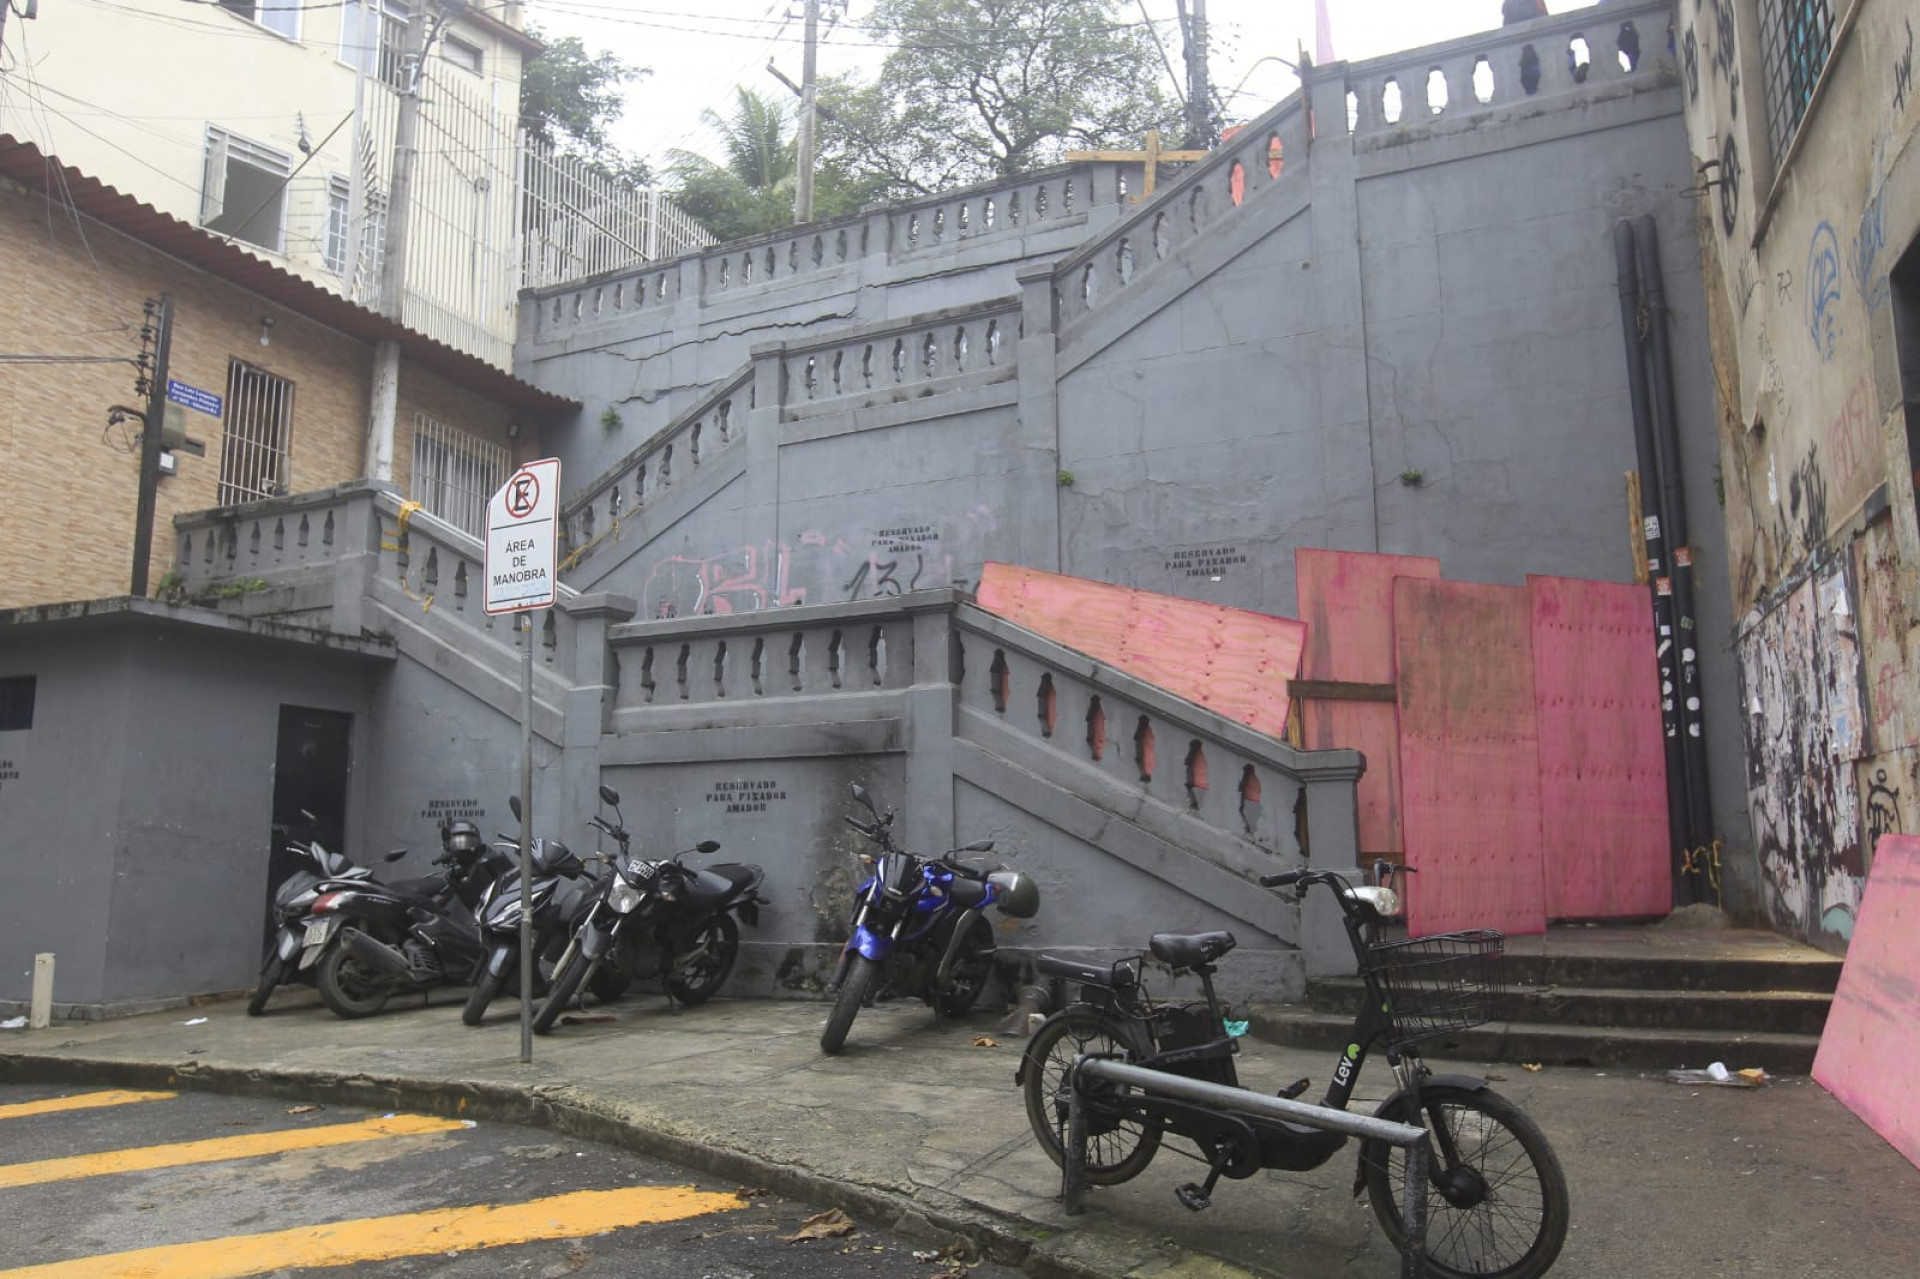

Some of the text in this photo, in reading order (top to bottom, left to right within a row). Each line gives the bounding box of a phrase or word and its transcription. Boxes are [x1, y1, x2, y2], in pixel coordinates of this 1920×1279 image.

[505, 538, 535, 554] ÁREA
[1174, 547, 1236, 559] RESERVADO
[512, 556, 527, 568] DE
[1165, 555, 1246, 570] PARA PIXADOR
[493, 568, 547, 587] MANOBRA
[1186, 566, 1227, 577] AMADOR
[715, 781, 776, 791] RESERVADO
[706, 791, 787, 802] PARA PIXADOR
[727, 803, 767, 813] AMADOR
[1333, 1055, 1353, 1087] Lev
